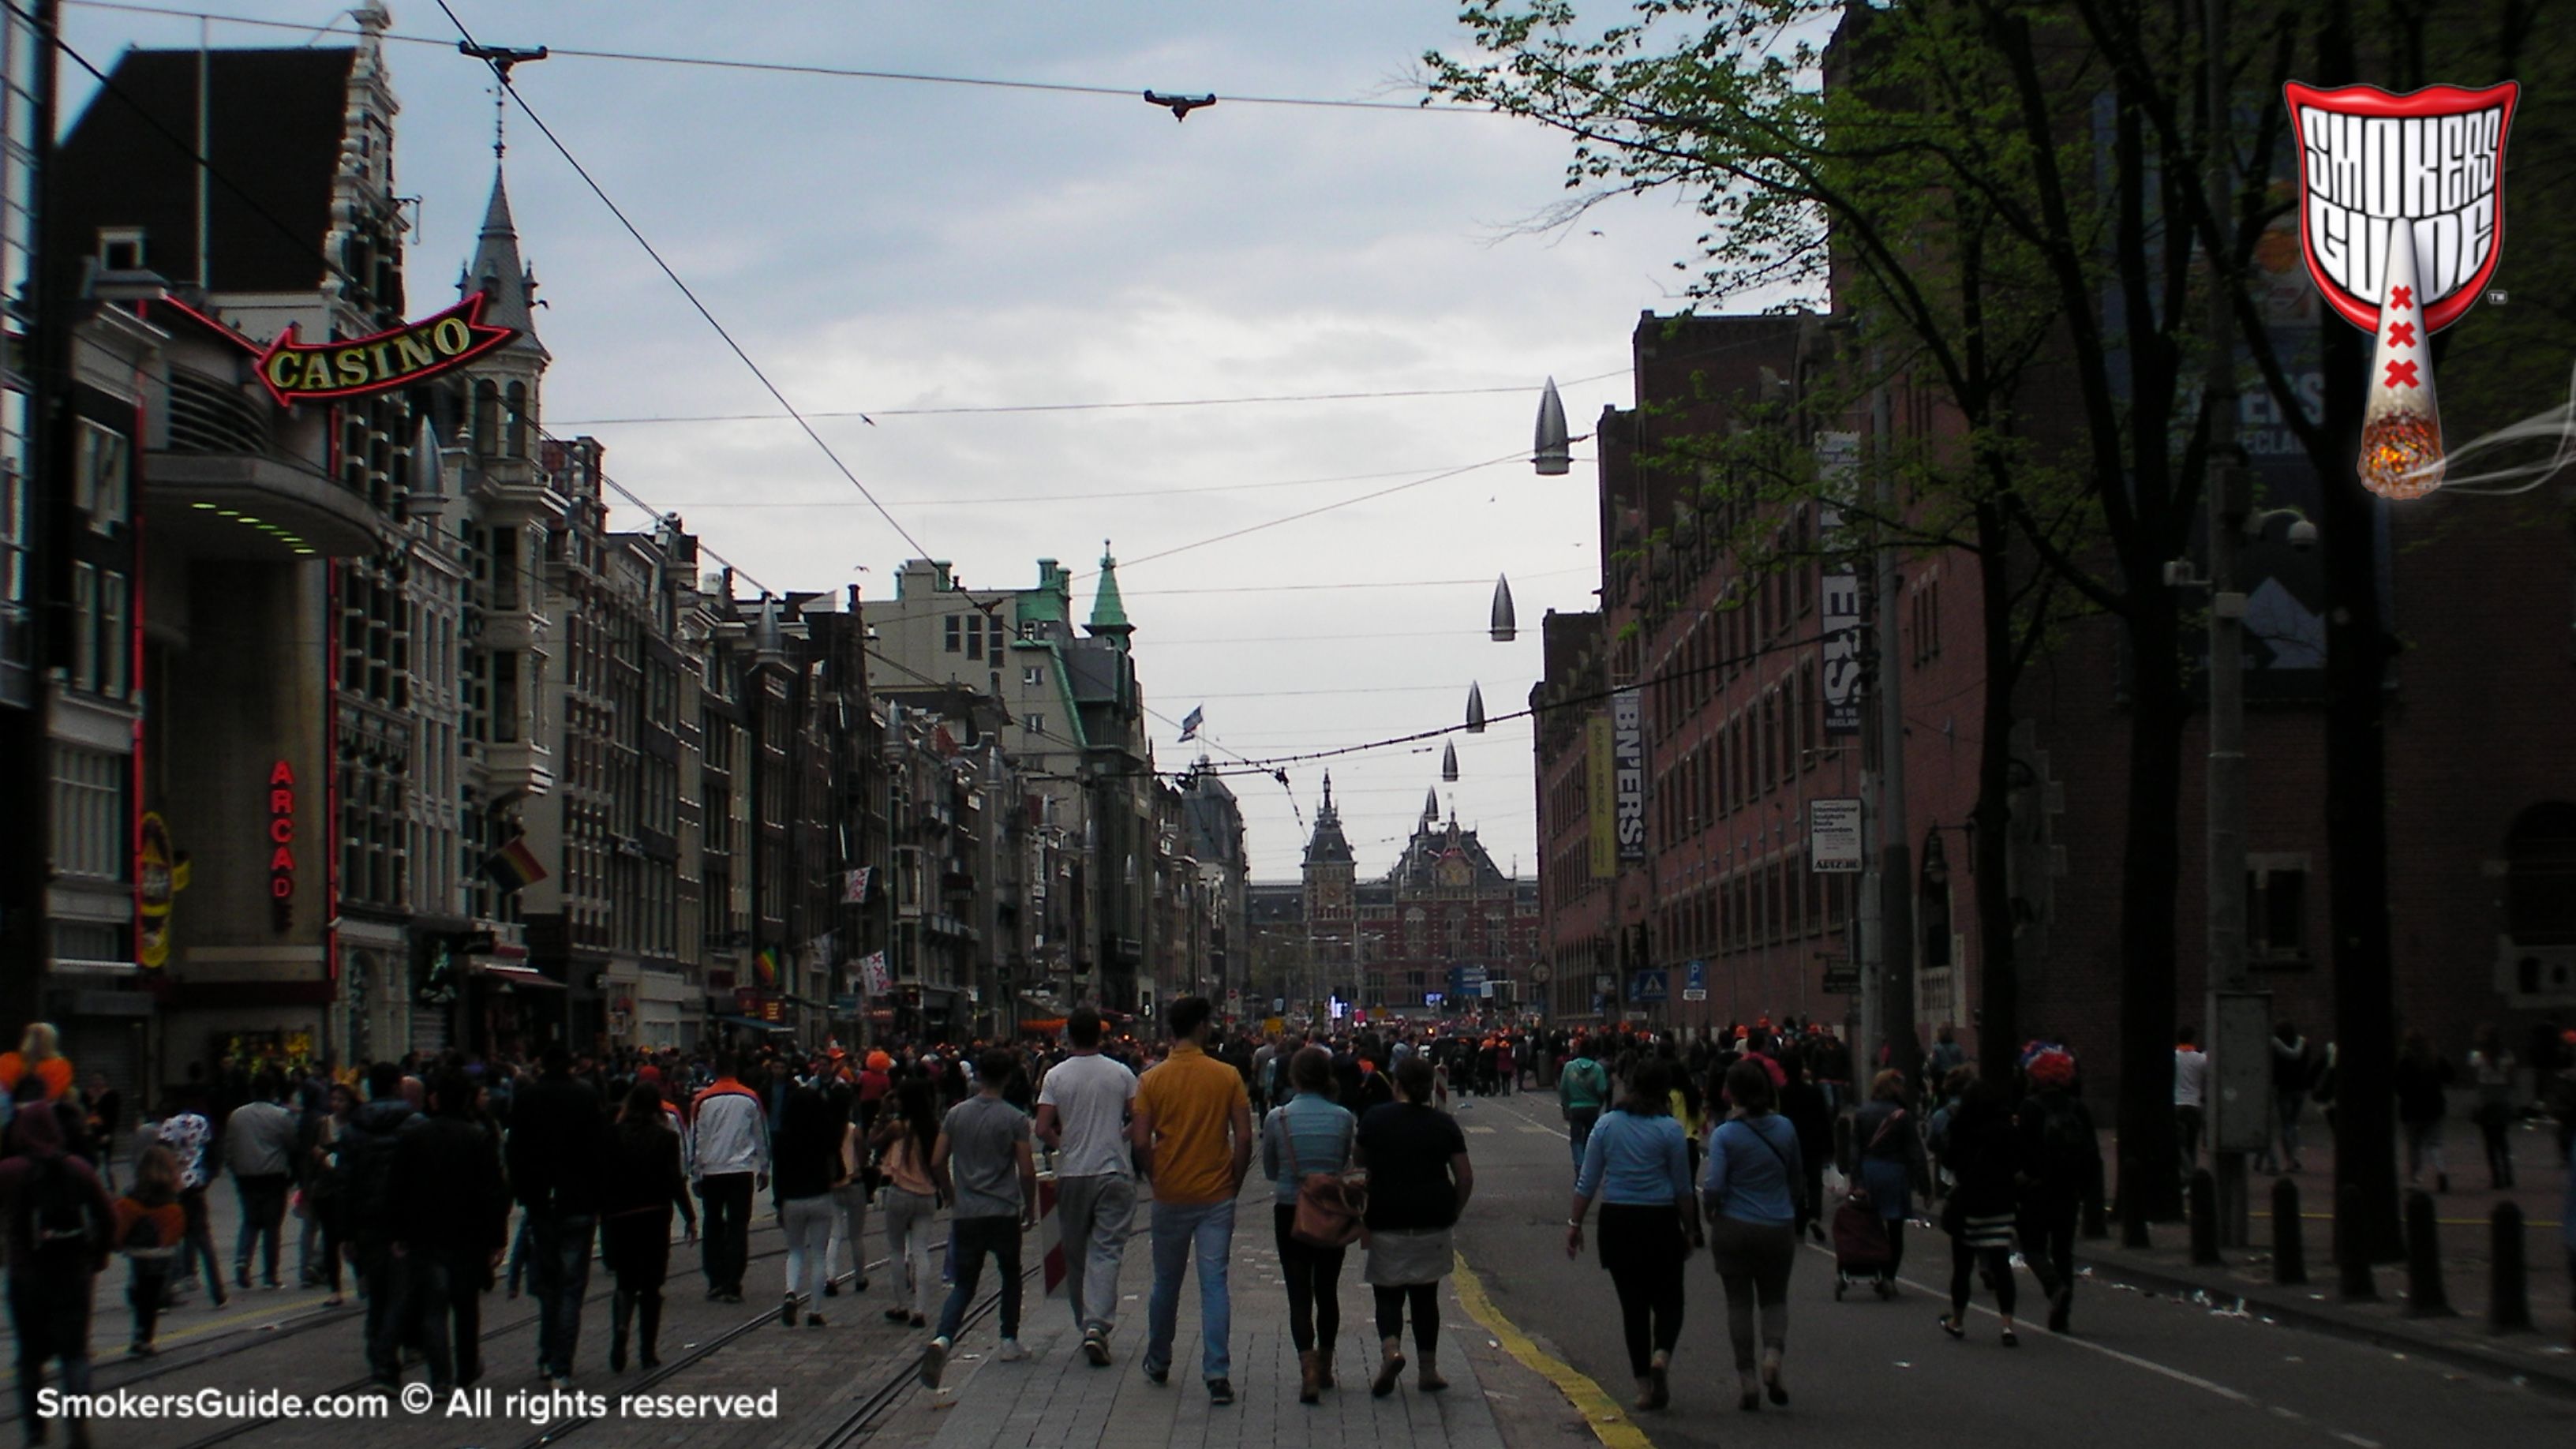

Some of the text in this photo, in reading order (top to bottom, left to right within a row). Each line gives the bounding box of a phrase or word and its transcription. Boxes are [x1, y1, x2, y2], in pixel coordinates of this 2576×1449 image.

[267, 317, 471, 390] CASINO
[1616, 704, 1644, 845] BN'ERS
[1690, 964, 1698, 982] P
